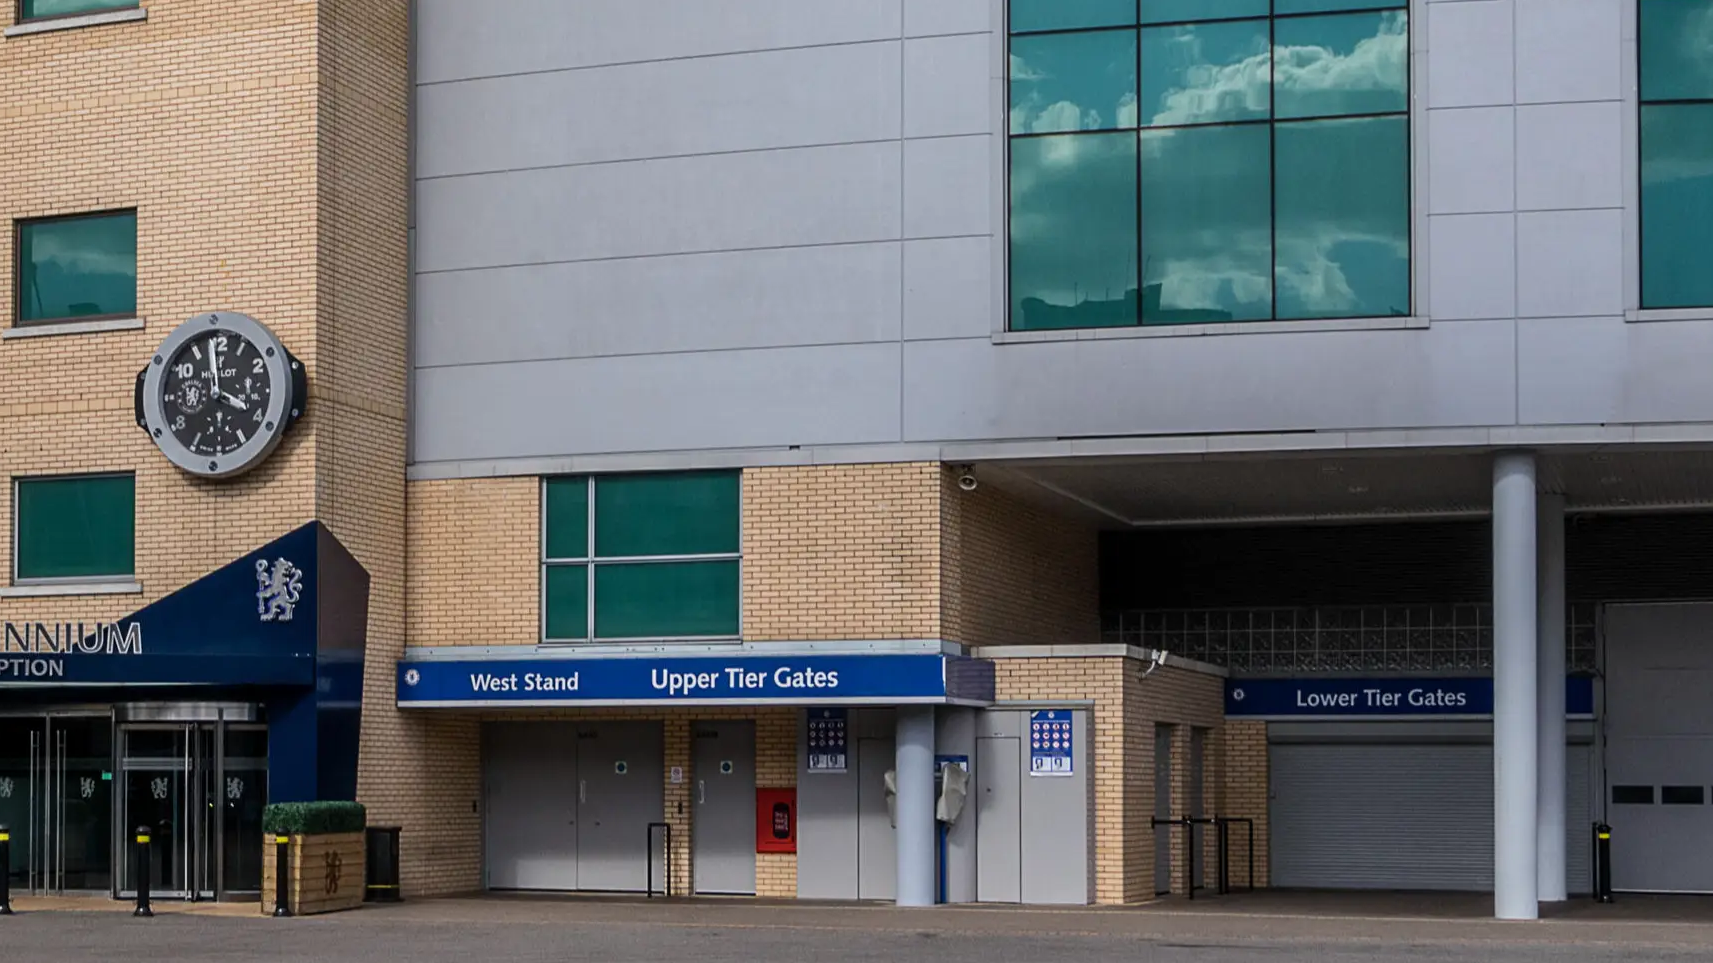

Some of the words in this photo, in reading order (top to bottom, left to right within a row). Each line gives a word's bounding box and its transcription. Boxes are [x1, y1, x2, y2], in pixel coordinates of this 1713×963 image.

[175, 363, 194, 379] 10
[201, 368, 237, 379] HULOT
[252, 358, 264, 374] 2
[175, 415, 186, 430] 8
[252, 408, 263, 423] 4
[470, 673, 516, 692] West
[524, 672, 579, 692] Stand
[651, 667, 718, 695] Upper
[725, 667, 768, 689] Tier
[773, 667, 839, 688] Gates
[1296, 689, 1357, 707] Lower
[1364, 689, 1402, 707] Tier
[1408, 689, 1467, 707] Gates
